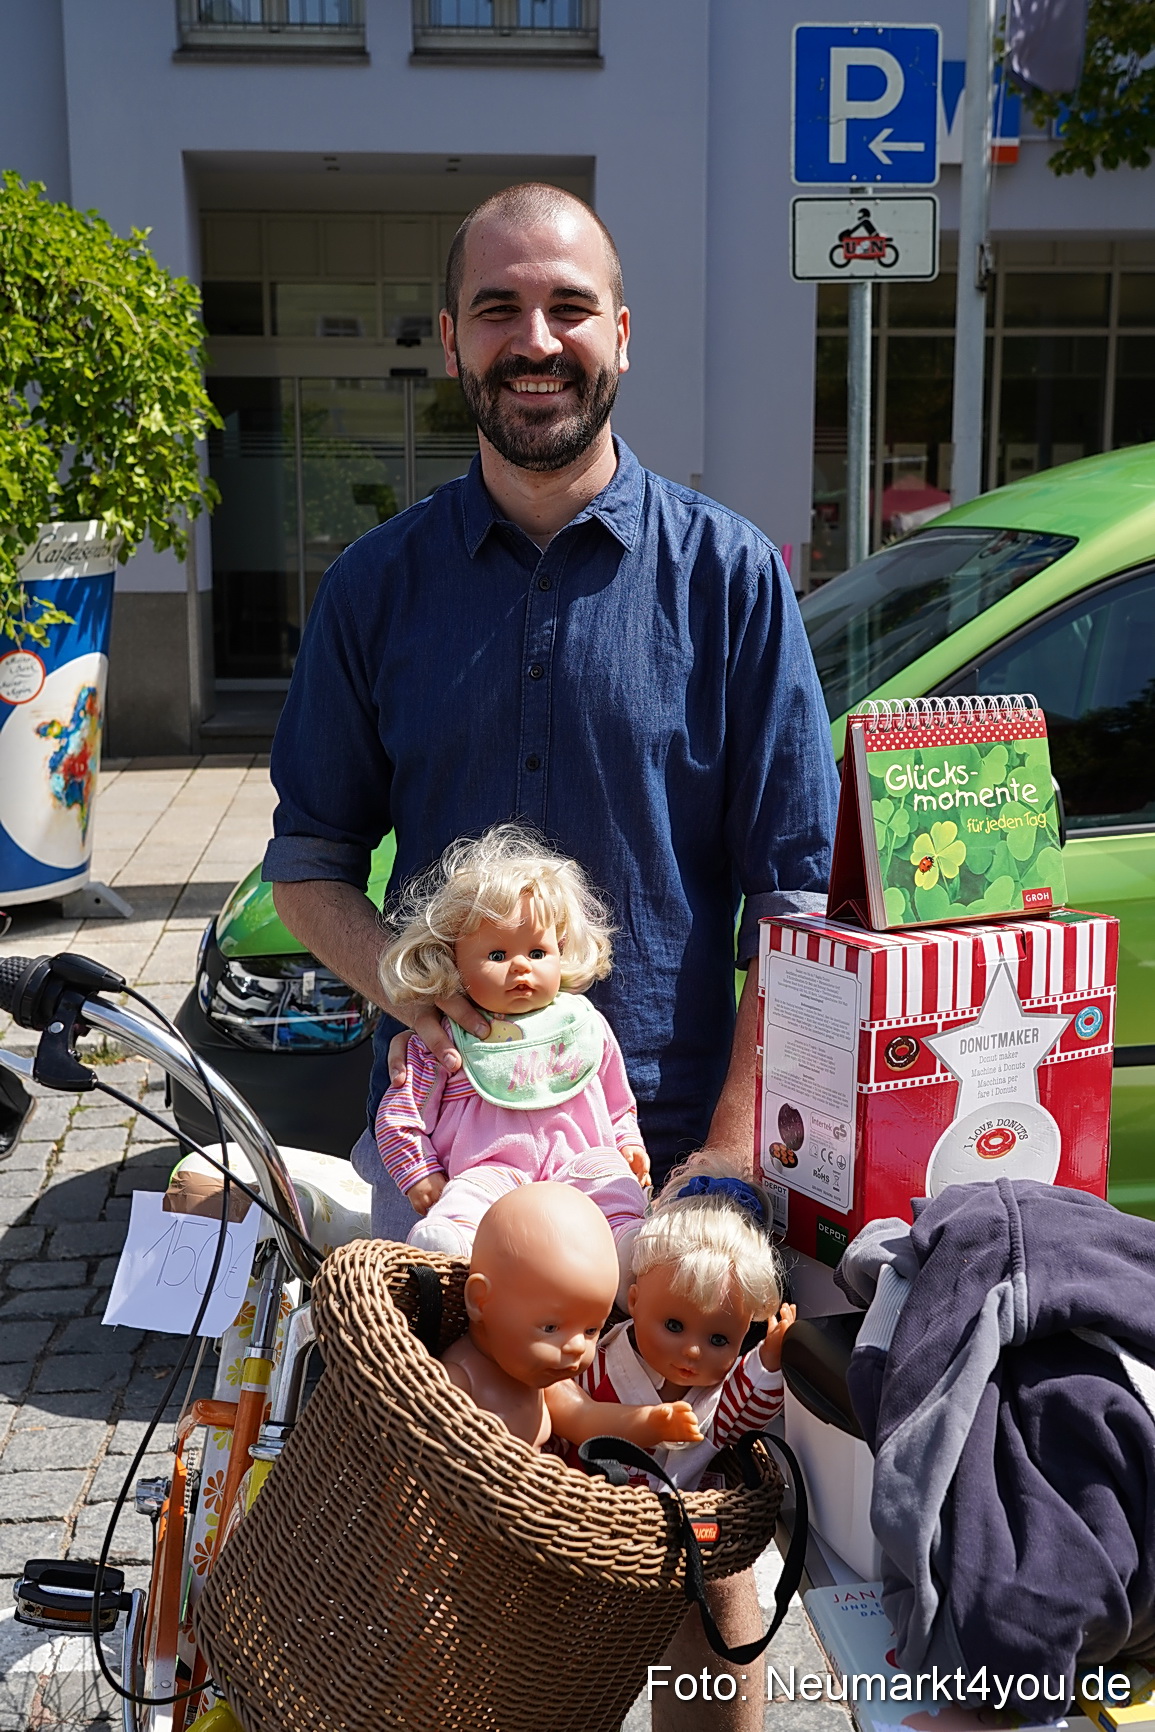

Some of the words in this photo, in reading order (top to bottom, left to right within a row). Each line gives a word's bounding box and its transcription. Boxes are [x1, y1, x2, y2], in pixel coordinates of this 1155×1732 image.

[829, 47, 905, 164] P
[885, 761, 978, 791] Glücks-
[914, 778, 1039, 811] momente
[967, 816, 984, 833] für
[985, 814, 1023, 834] jeden
[1024, 811, 1047, 828] Tag
[1025, 892, 1050, 903] GROH
[960, 1028, 1039, 1055] DONUTMAKER
[979, 1054, 998, 1064] Donut
[998, 1051, 1018, 1060] maker
[971, 1067, 996, 1077] Machine
[1004, 1062, 1026, 1072] Donuts
[977, 1076, 1006, 1088] Macchina
[1007, 1075, 1018, 1085] per
[977, 1089, 990, 1099] fare
[994, 1085, 1018, 1096] Donuts
[811, 1115, 833, 1132] Intertek
[968, 1121, 993, 1141] LOVE
[996, 1118, 1028, 1140] DONUTS
[820, 1147, 833, 1166] CE
[764, 1180, 787, 1195] DEPOT
[818, 1222, 847, 1243] DEPOT
